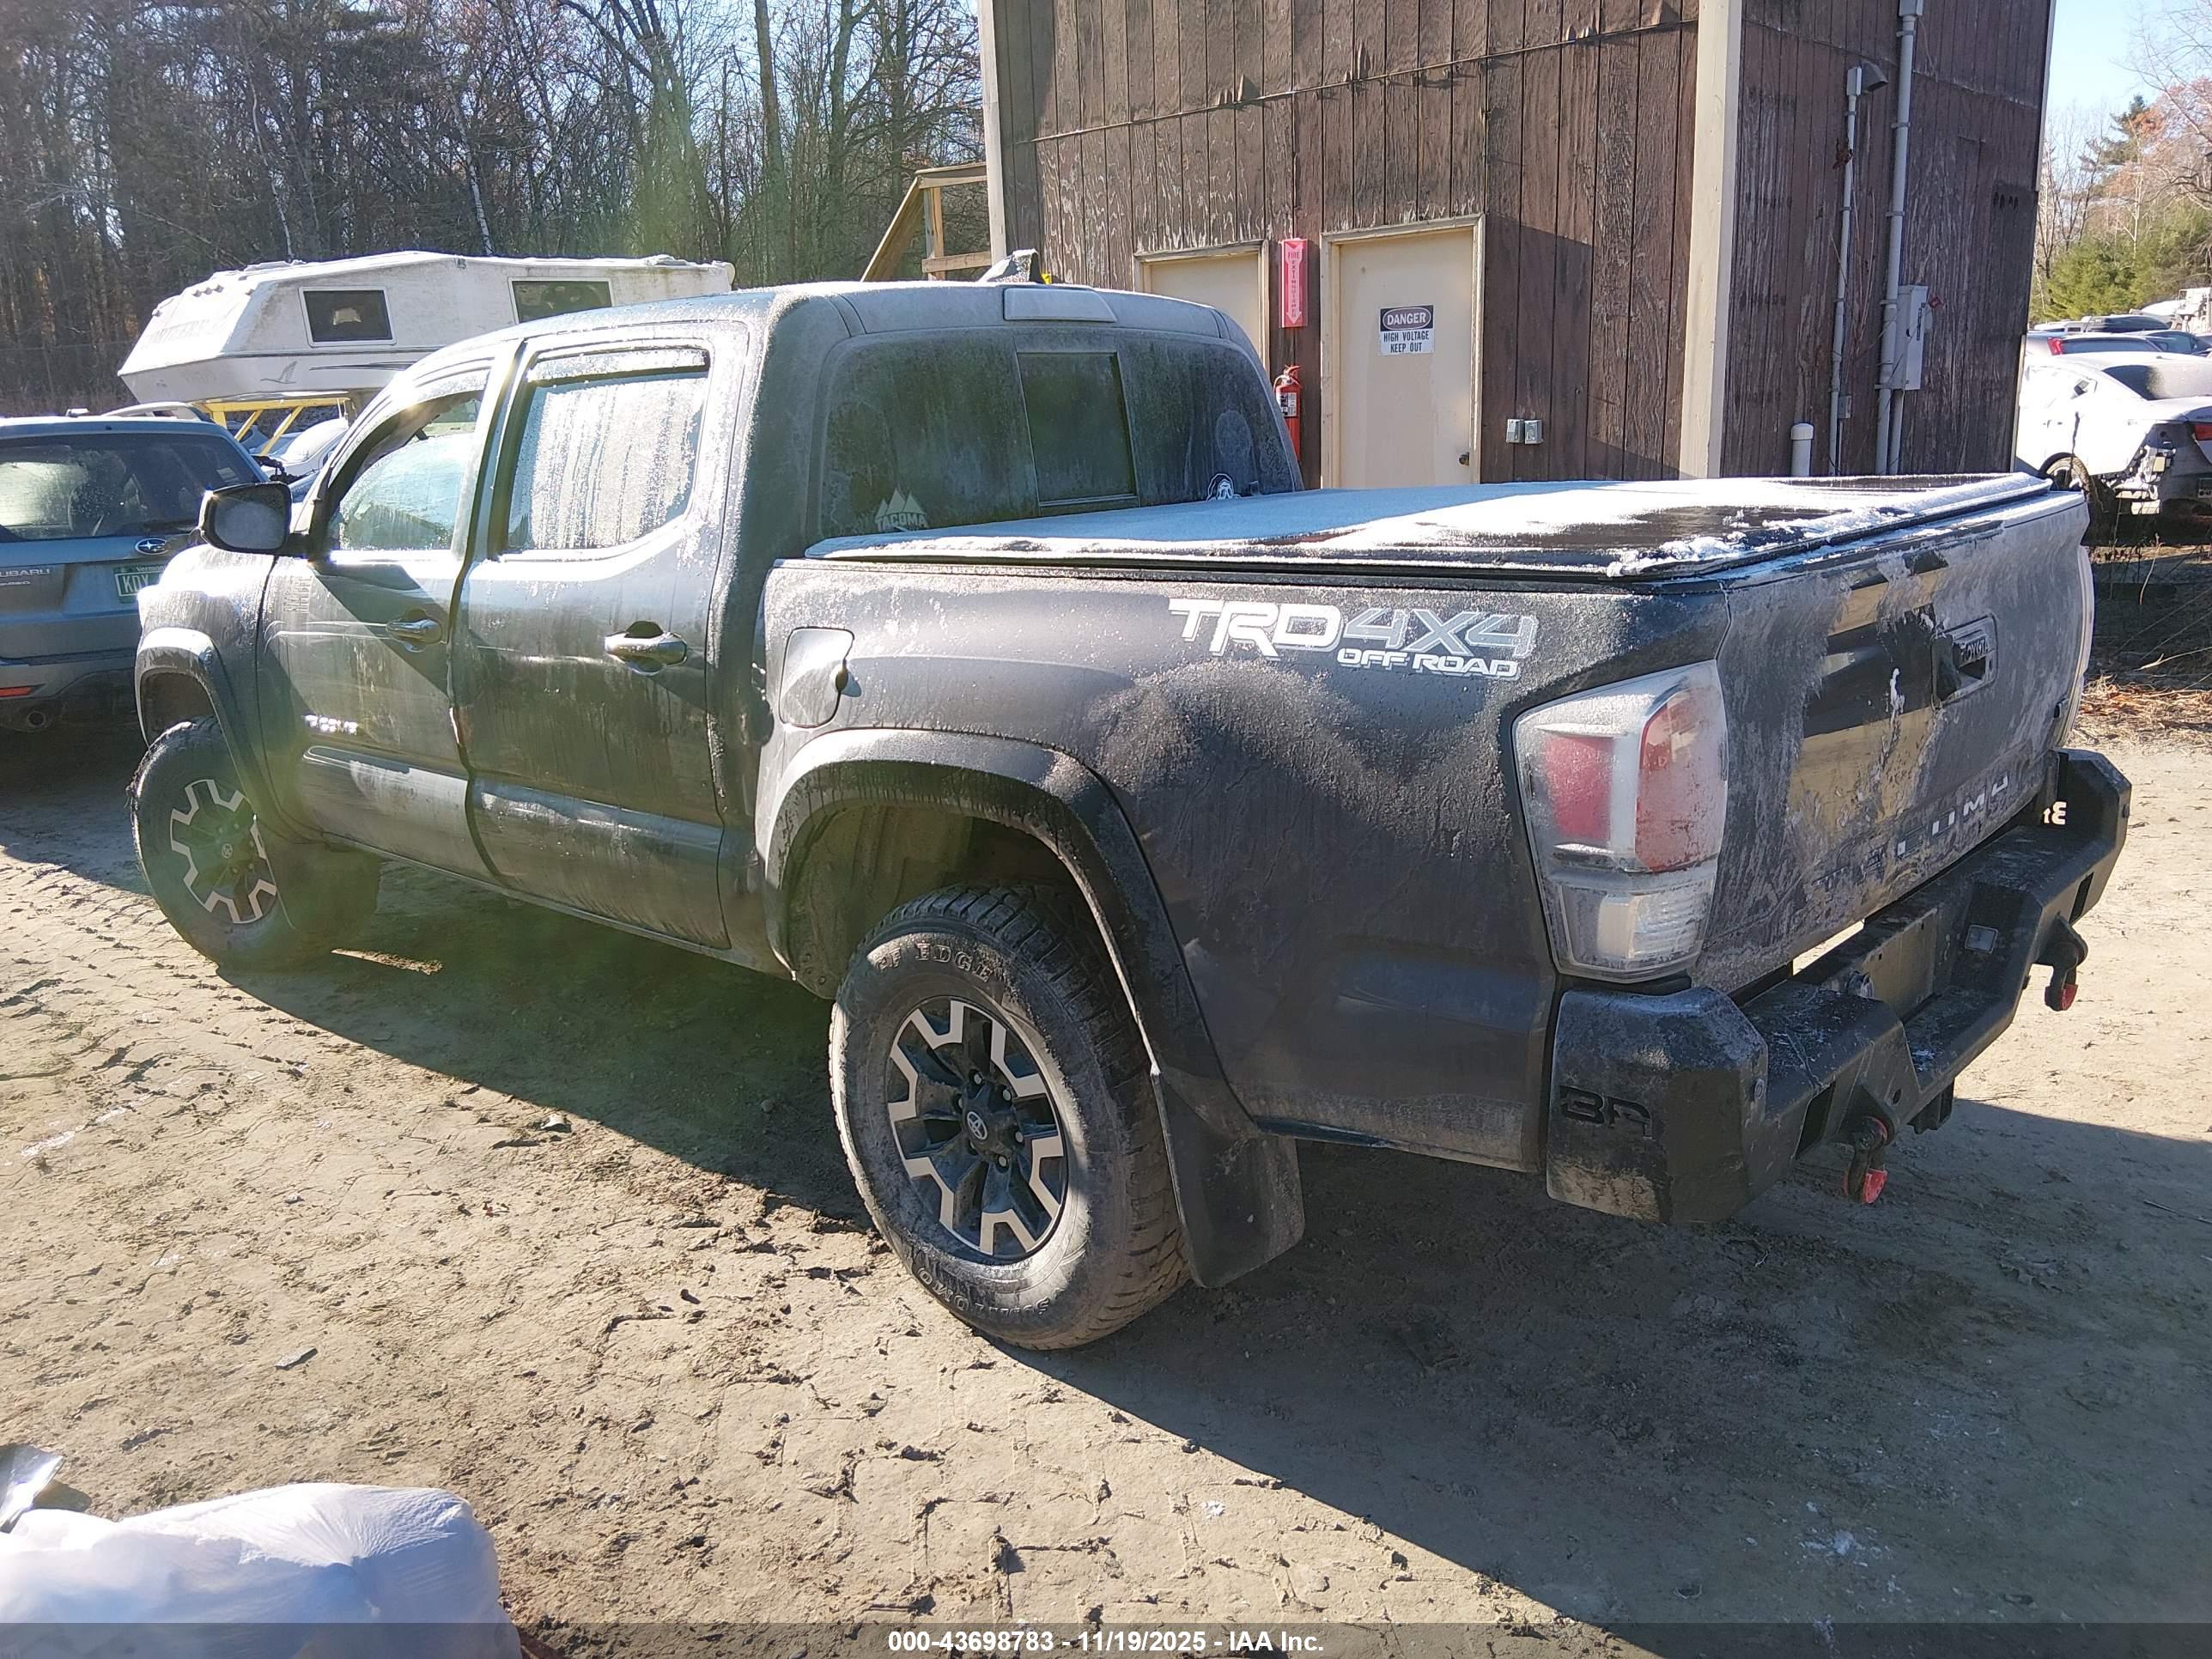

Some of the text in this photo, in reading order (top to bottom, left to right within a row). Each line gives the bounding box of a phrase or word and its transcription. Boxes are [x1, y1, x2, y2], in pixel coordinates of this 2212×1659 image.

[1287, 251, 1300, 259] FIRE
[1386, 312, 1426, 325] DANGER
[1383, 330, 1430, 343] HIGH VOLTAGE
[1390, 342, 1423, 353] KEEP OUT
[874, 513, 928, 532] TACOMA
[0, 568, 50, 578] UBARU
[1169, 599, 1540, 661] TRD 4X4
[1337, 647, 1522, 682] OFF ROAD
[915, 942, 994, 983] EDGE
